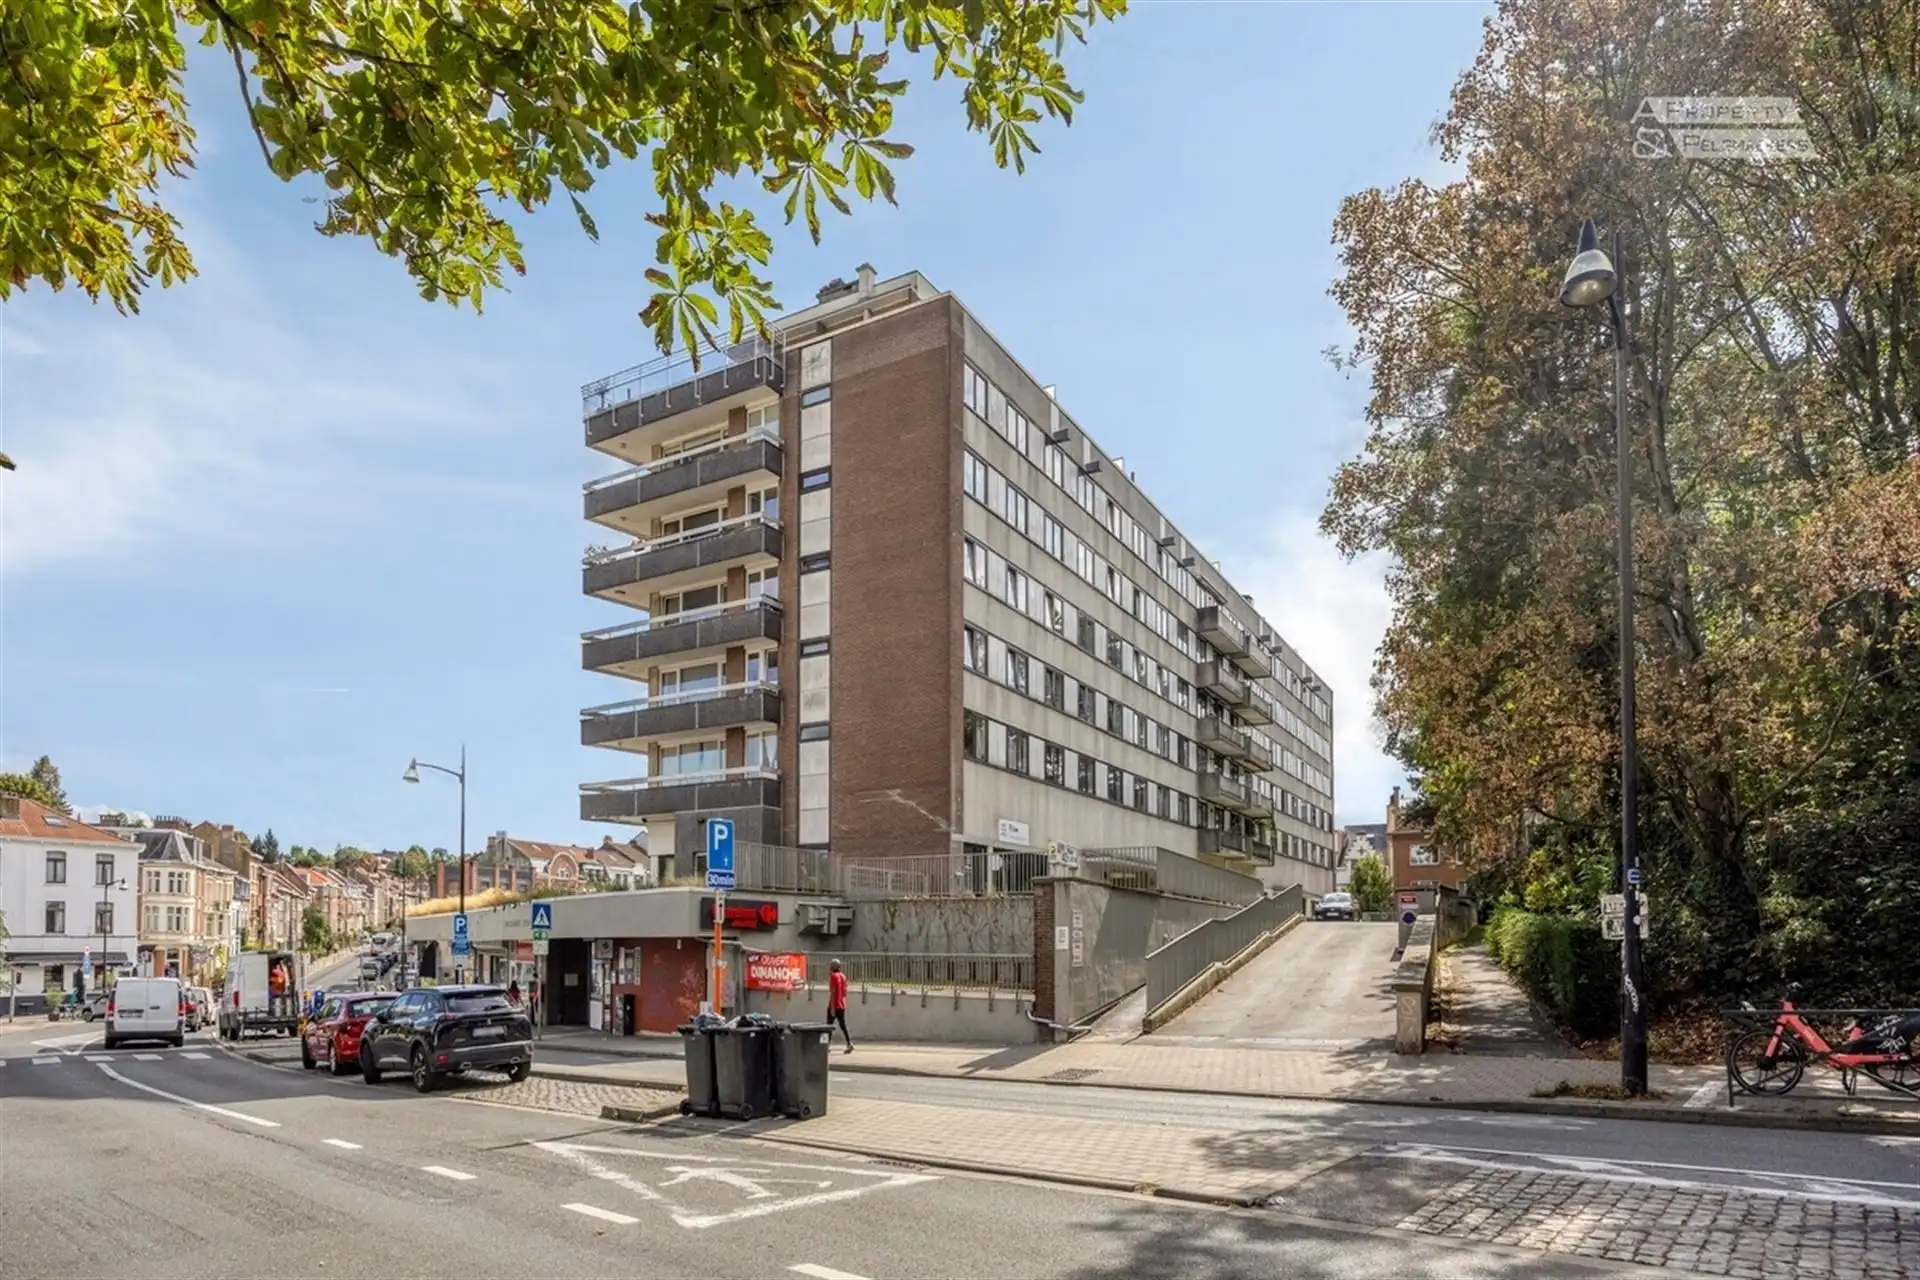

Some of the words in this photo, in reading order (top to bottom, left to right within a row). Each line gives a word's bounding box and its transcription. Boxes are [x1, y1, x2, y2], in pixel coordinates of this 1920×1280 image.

[714, 823, 729, 851] P
[455, 917, 466, 933] P
[750, 966, 801, 980] DIMANCHE
